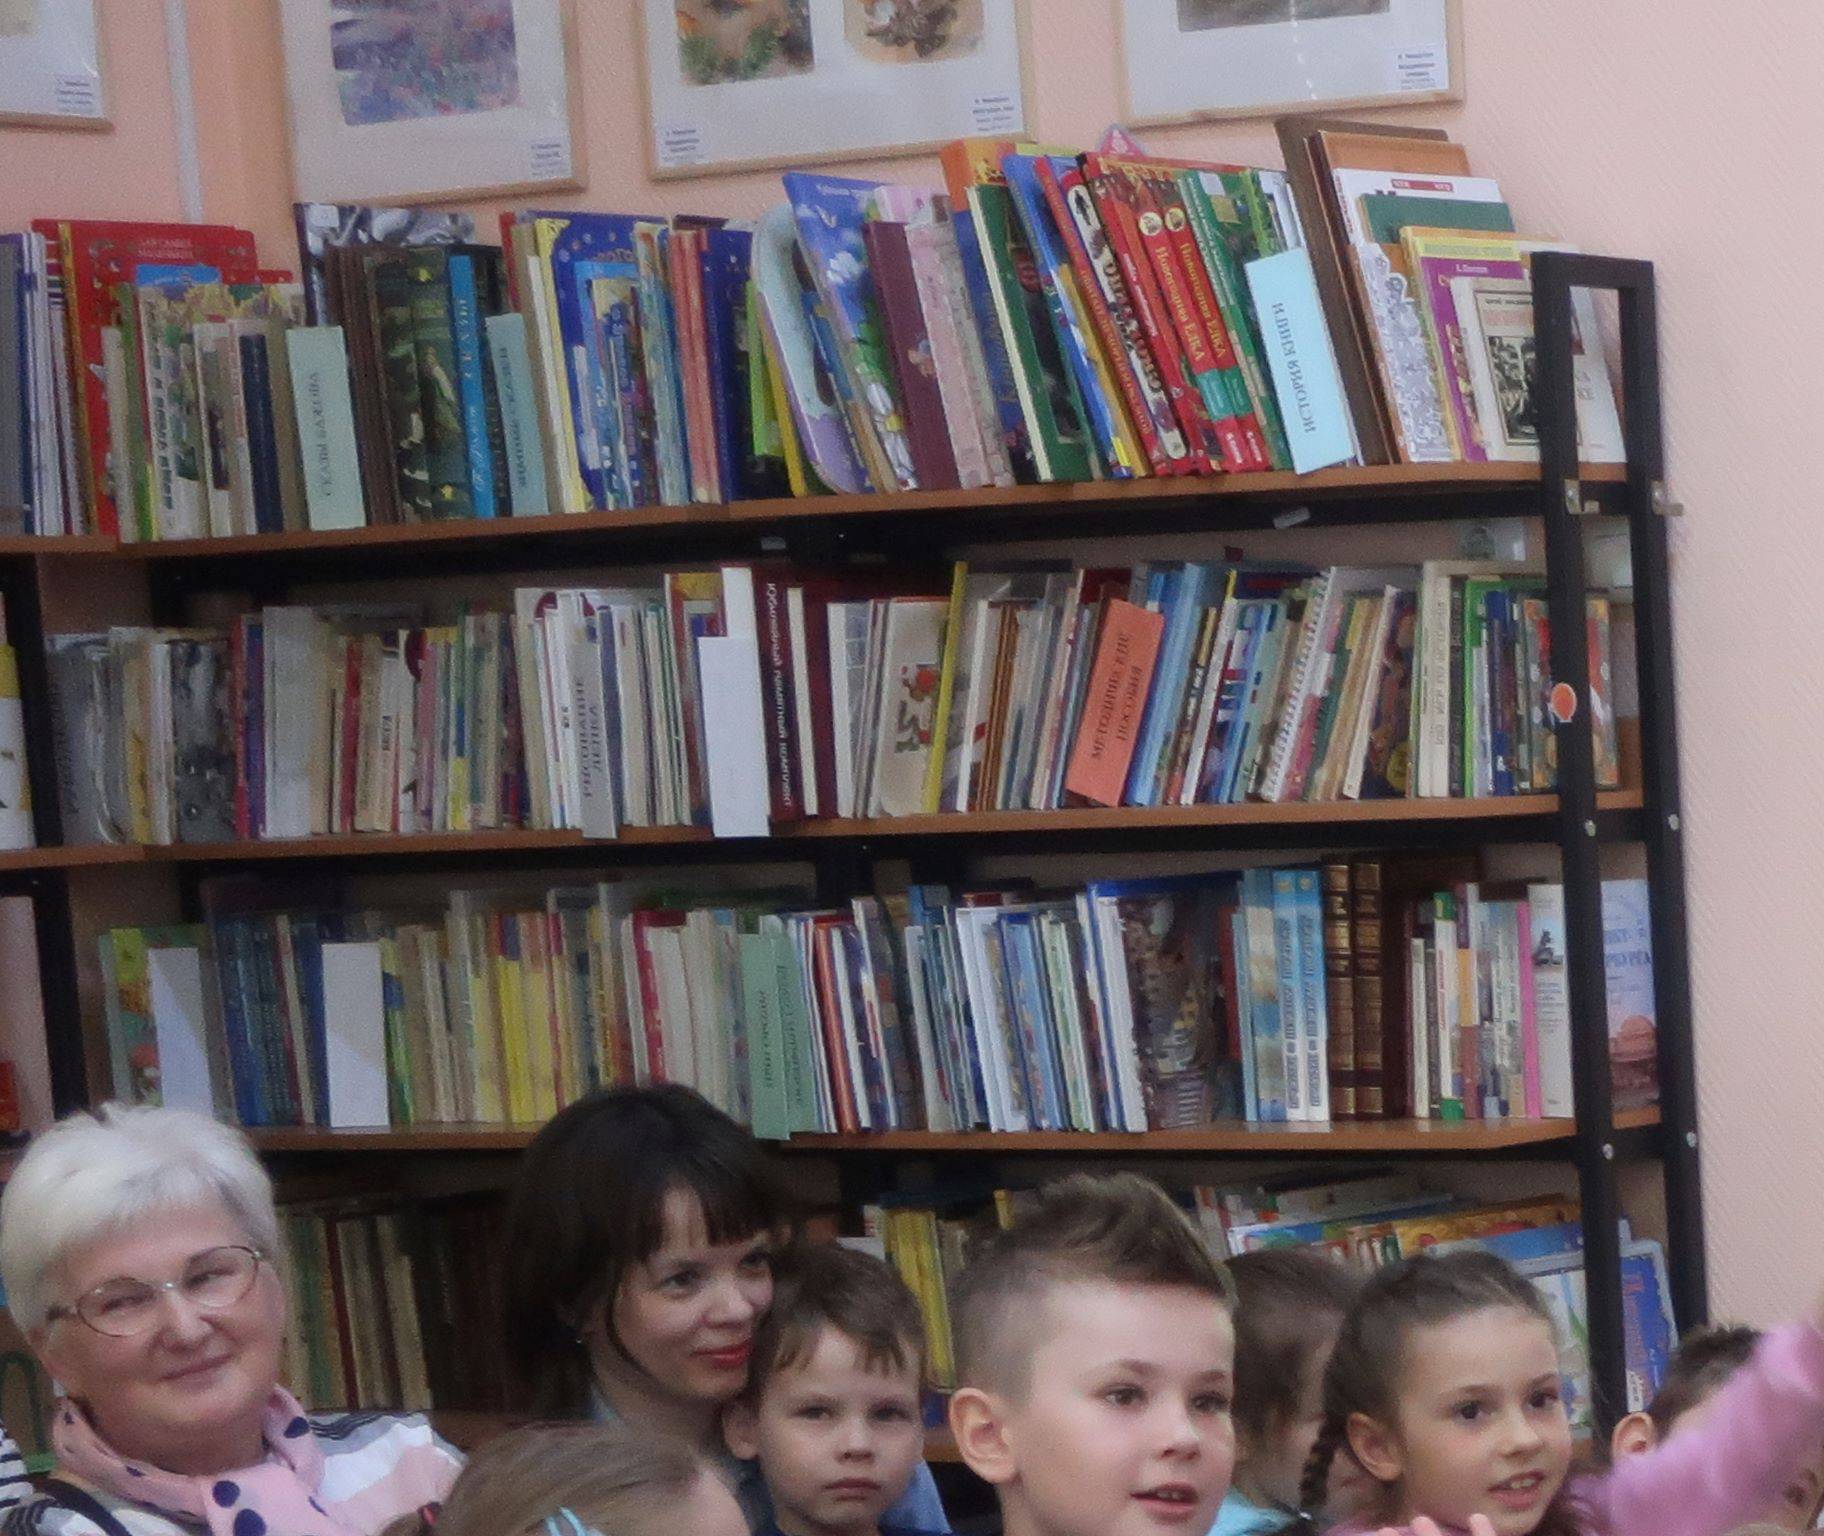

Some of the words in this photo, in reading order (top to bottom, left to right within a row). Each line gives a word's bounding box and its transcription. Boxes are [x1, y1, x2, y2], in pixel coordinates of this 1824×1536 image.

[1271, 302, 1297, 357] КНИГИ
[1287, 359, 1317, 433] ИСТОРИЯ
[1090, 628, 1131, 760] МЕТОДИЧЕСКИЕ
[1115, 665, 1143, 742] ПОСОБИЯ
